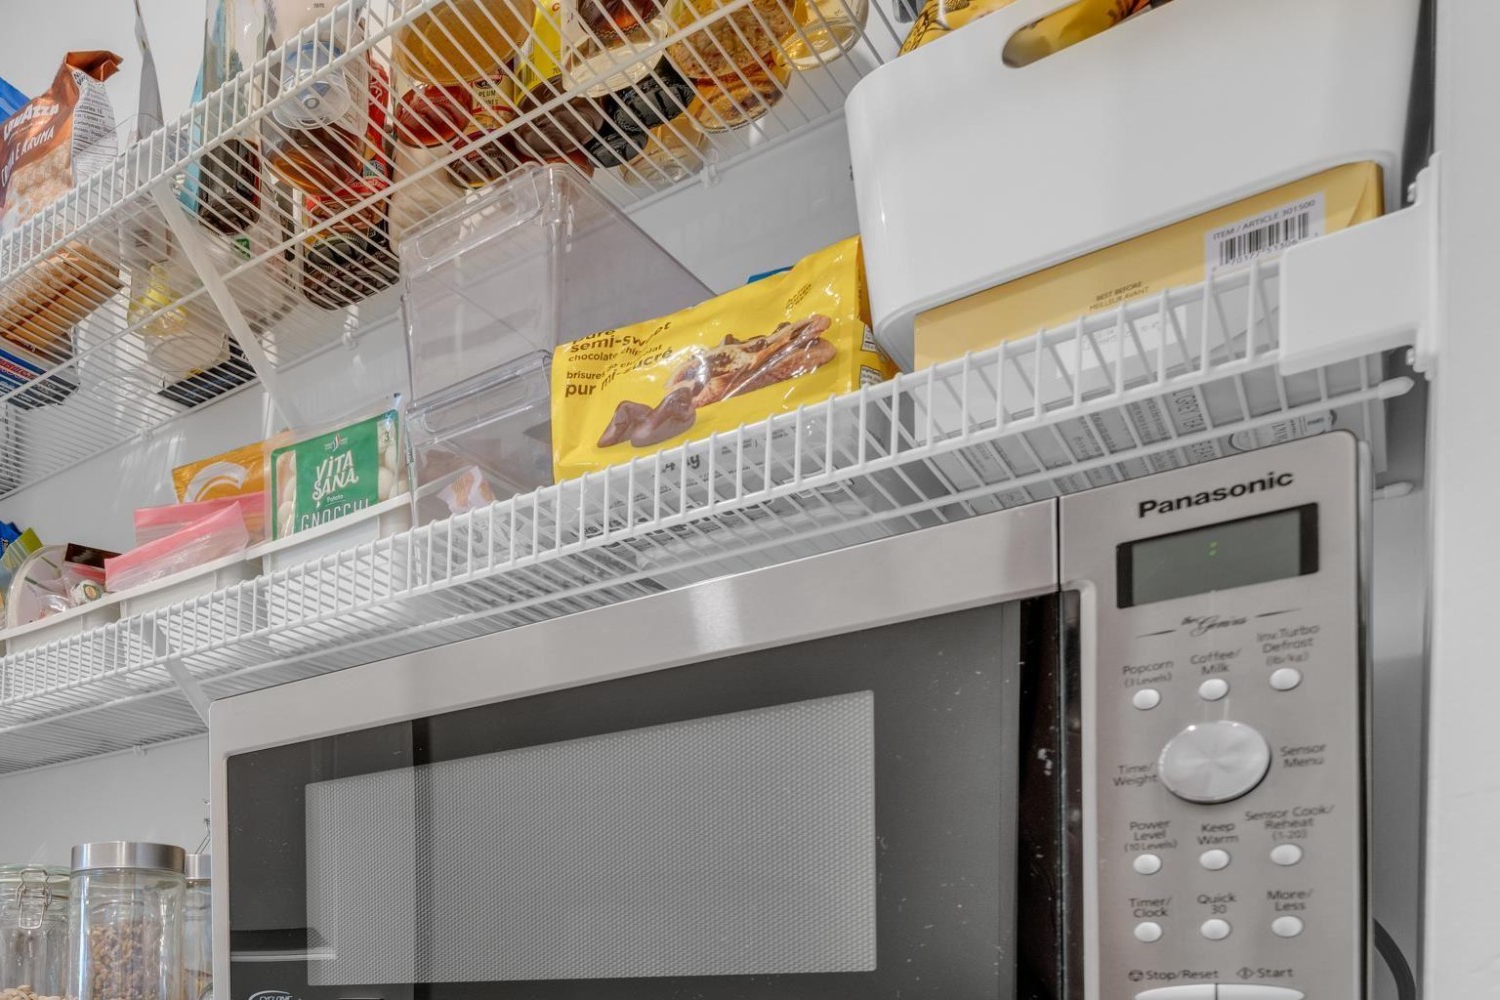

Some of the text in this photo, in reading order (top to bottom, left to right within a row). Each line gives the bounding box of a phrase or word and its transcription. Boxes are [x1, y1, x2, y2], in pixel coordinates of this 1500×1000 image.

[1213, 227, 1236, 241] ITEM
[1242, 213, 1280, 230] ARTICLE
[1096, 280, 1142, 301] BEST BEFORE
[565, 384, 596, 398] pur
[1138, 472, 1294, 518] Panasonic
[1262, 637, 1314, 654] Defrost
[1190, 648, 1242, 666] Coffee/
[1122, 659, 1174, 677] Popcorn
[1201, 662, 1230, 675] Milk
[1278, 744, 1326, 757] Sensor
[1117, 762, 1155, 776] Time/
[1283, 756, 1325, 769] Menu
[1112, 773, 1158, 788] Weight
[1244, 804, 1335, 823] Sensor Cook/
[1128, 819, 1171, 832] Power
[1200, 822, 1236, 837] Keep
[1264, 817, 1315, 831] Reheat
[1134, 830, 1167, 842] Level
[1196, 832, 1239, 846] Warm
[1196, 892, 1236, 905] Quick
[1266, 889, 1314, 902] More/
[1130, 896, 1172, 909] Timer/
[1274, 900, 1306, 912] Less
[1133, 906, 1169, 919] Clock
[1211, 904, 1227, 915] 30
[1146, 969, 1219, 982] Stop/Reset
[1256, 968, 1294, 980] Start
